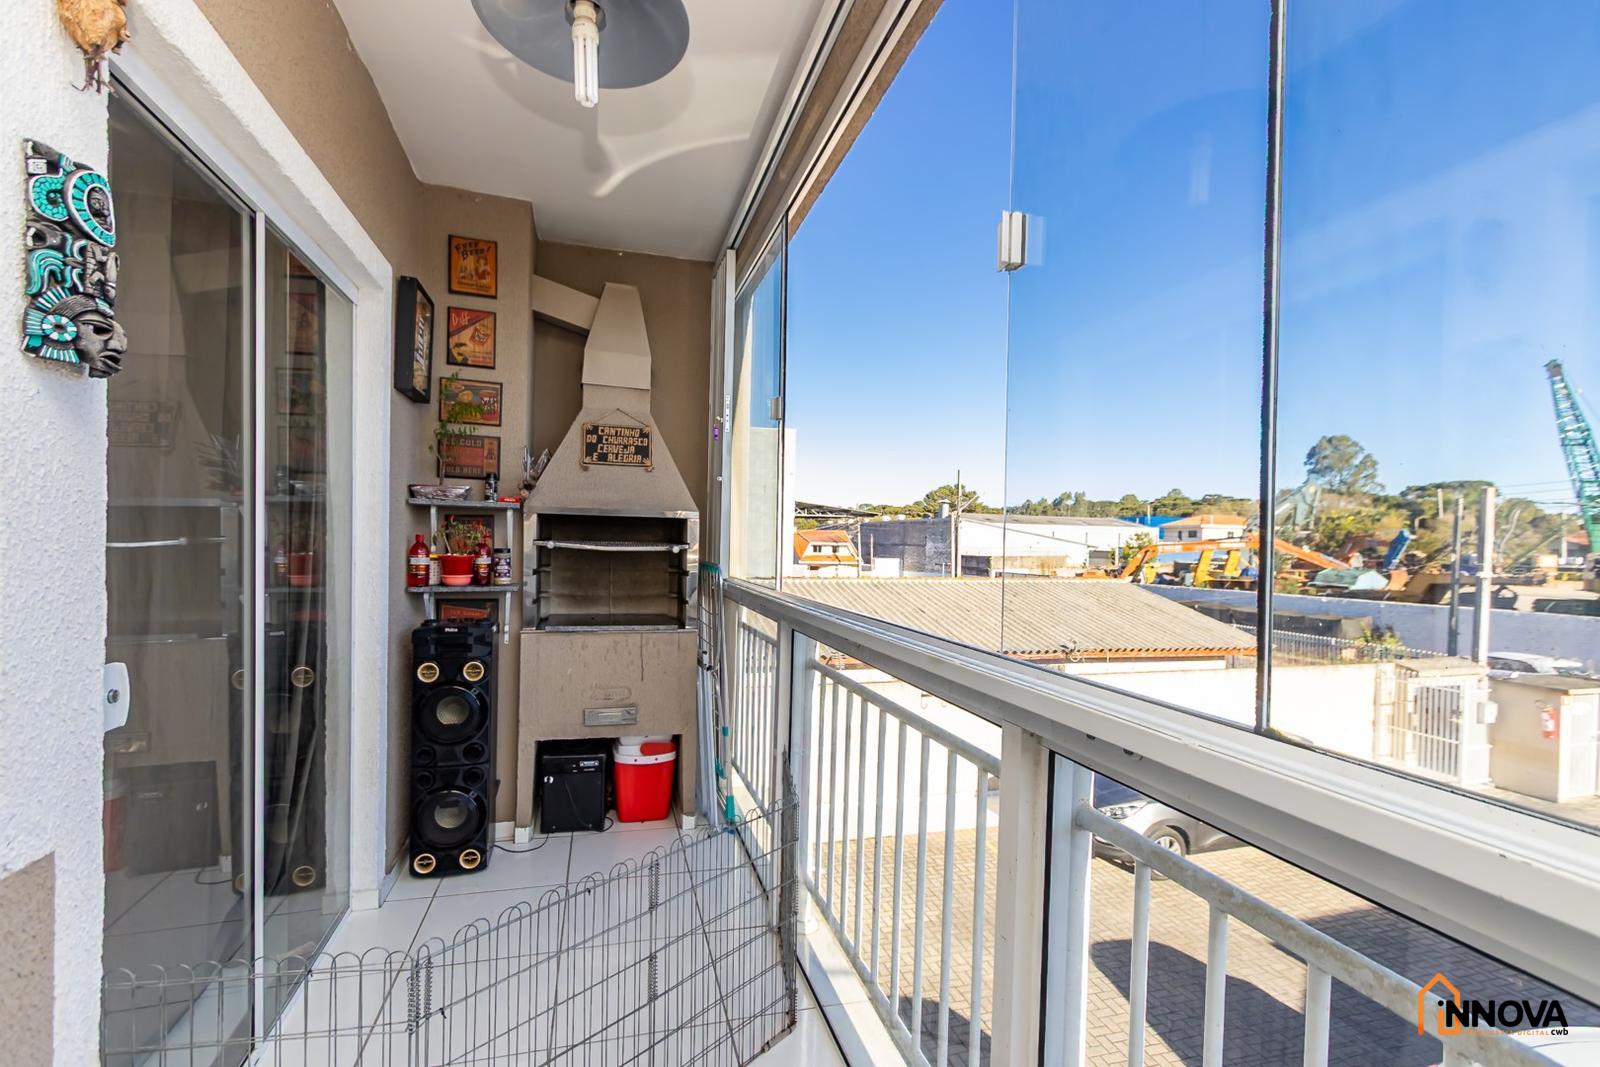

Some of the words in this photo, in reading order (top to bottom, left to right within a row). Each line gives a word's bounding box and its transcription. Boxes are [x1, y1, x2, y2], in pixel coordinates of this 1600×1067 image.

[598, 427, 640, 437] CANTINHO
[586, 434, 597, 443] DO
[602, 436, 648, 446] CHURRASCO
[597, 444, 635, 454] CERVEJA
[592, 452, 599, 461] E
[607, 453, 642, 463] ALEGRIA
